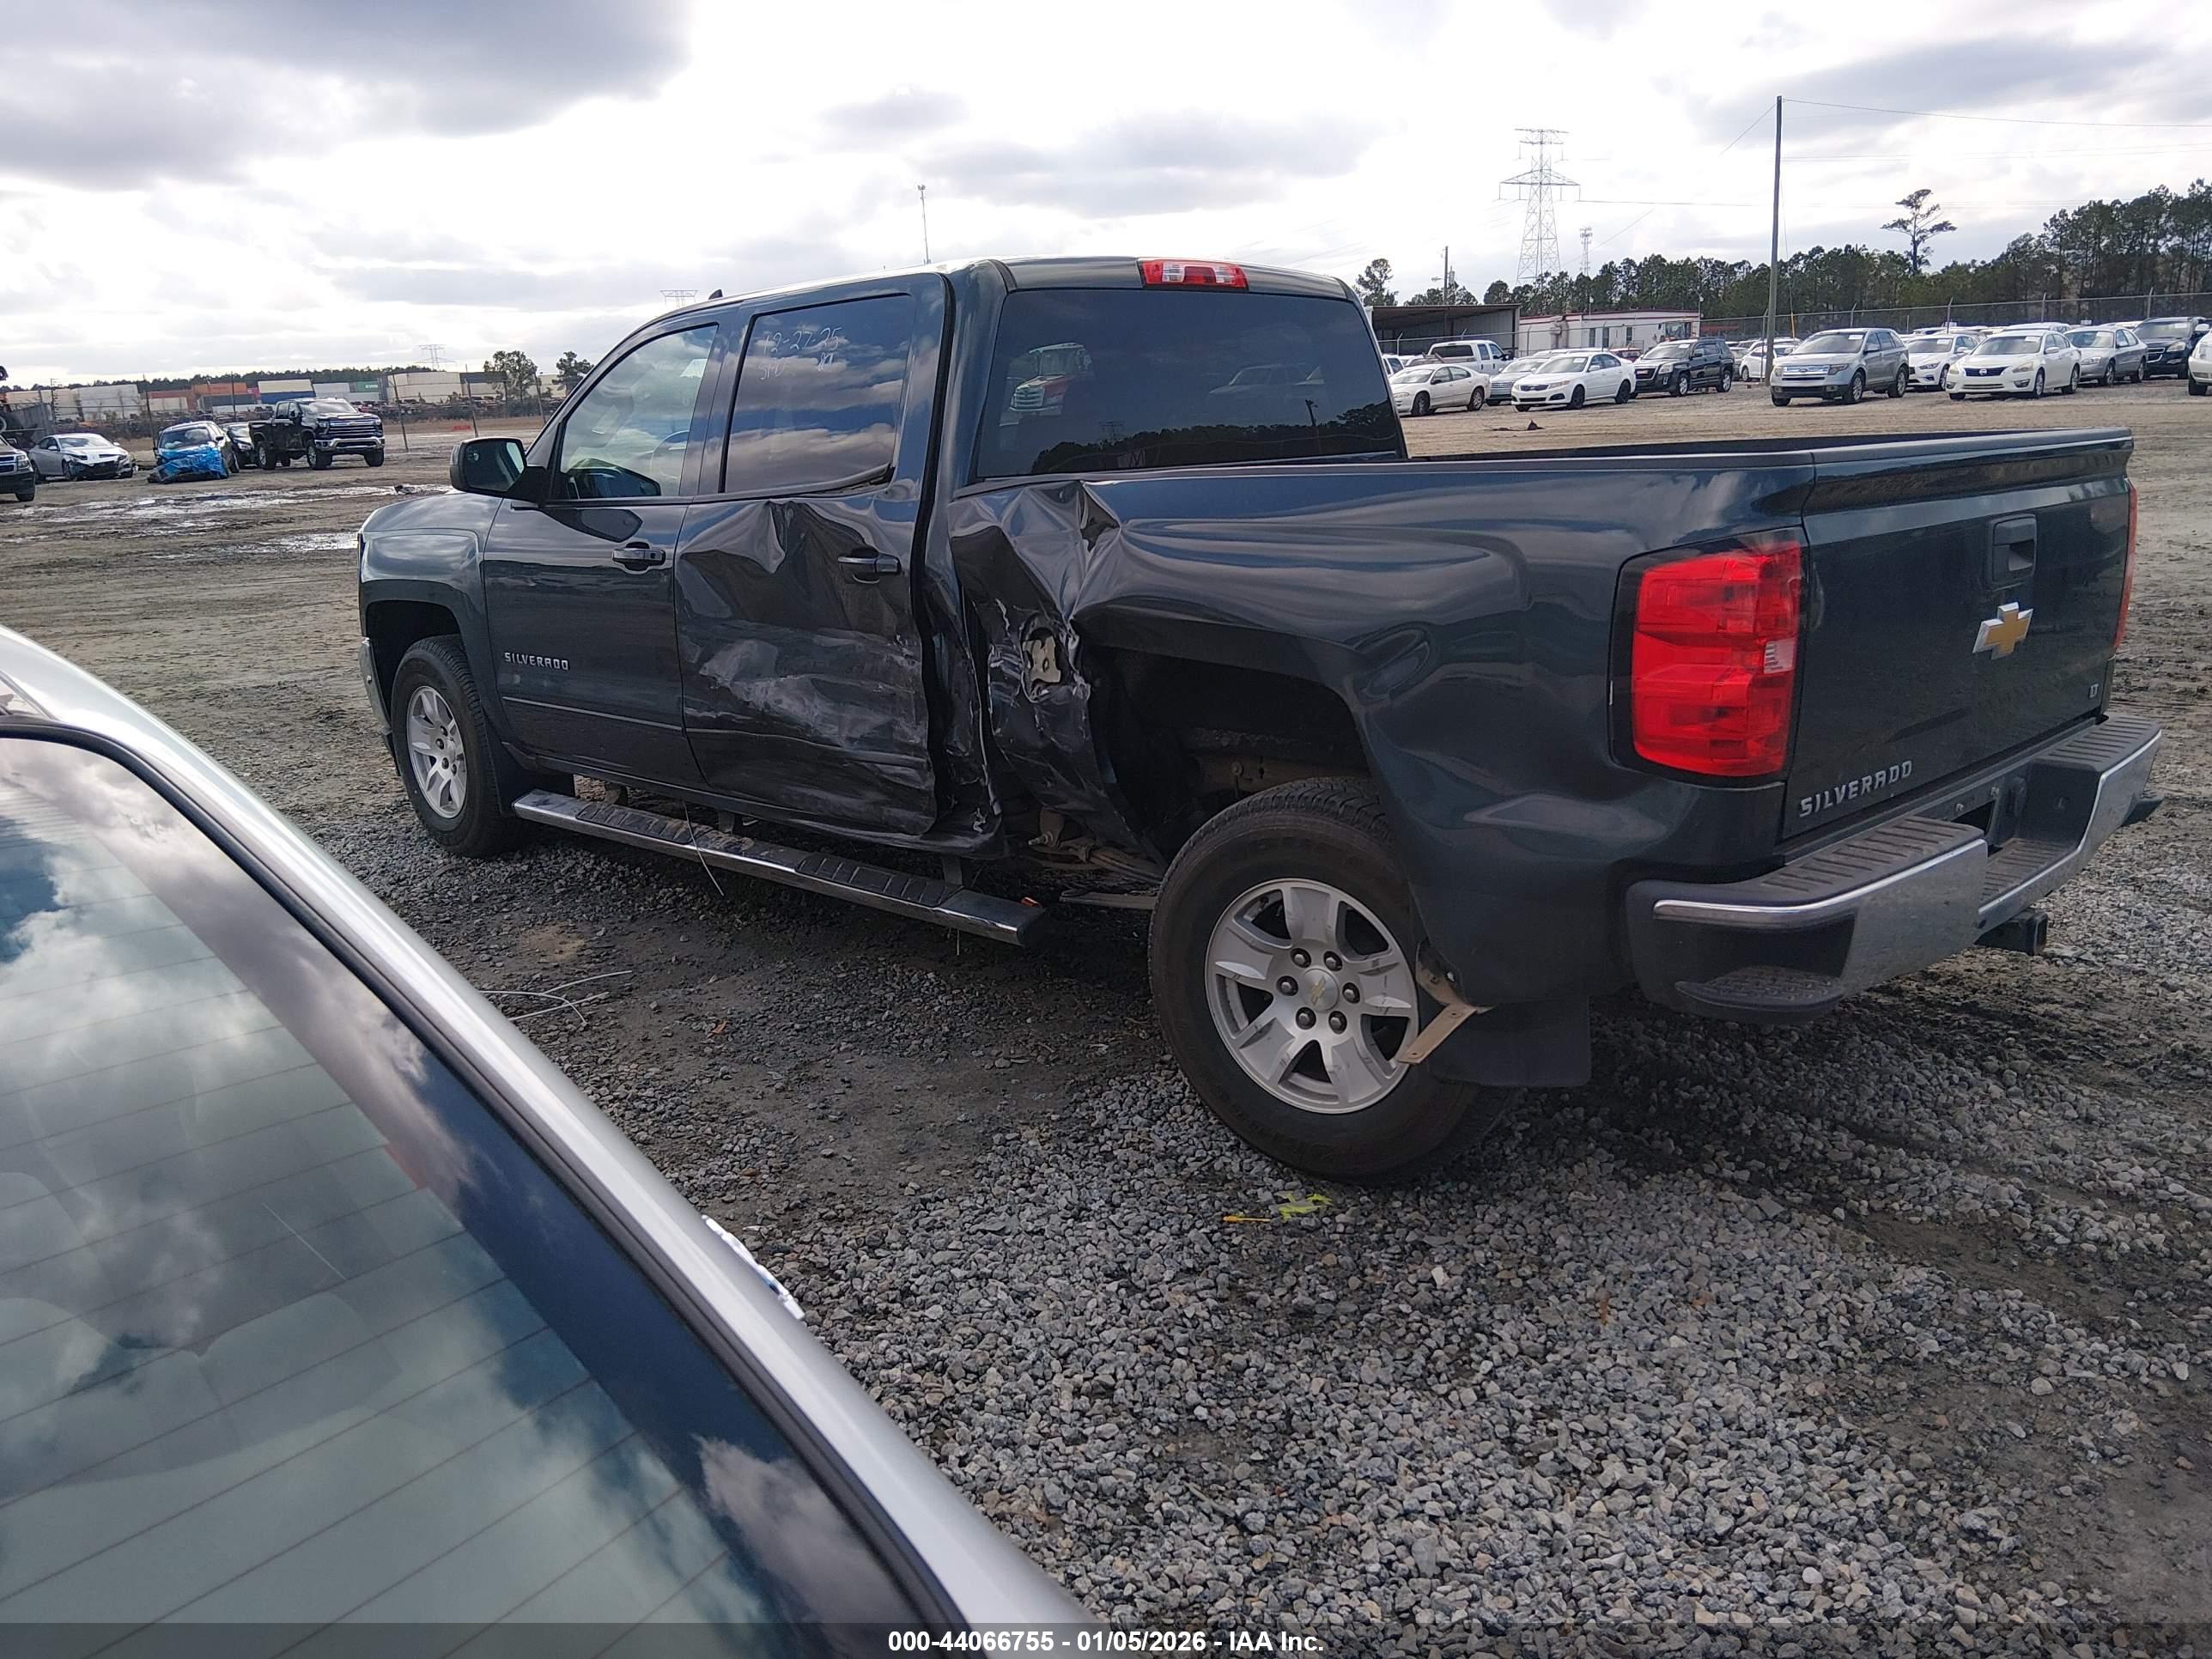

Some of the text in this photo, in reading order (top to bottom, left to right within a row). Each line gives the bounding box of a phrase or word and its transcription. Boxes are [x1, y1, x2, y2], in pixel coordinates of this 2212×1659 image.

[504, 652, 570, 671] SILVERADO
[2089, 684, 2100, 698] LT
[1799, 760, 1913, 818] SILVERADO
